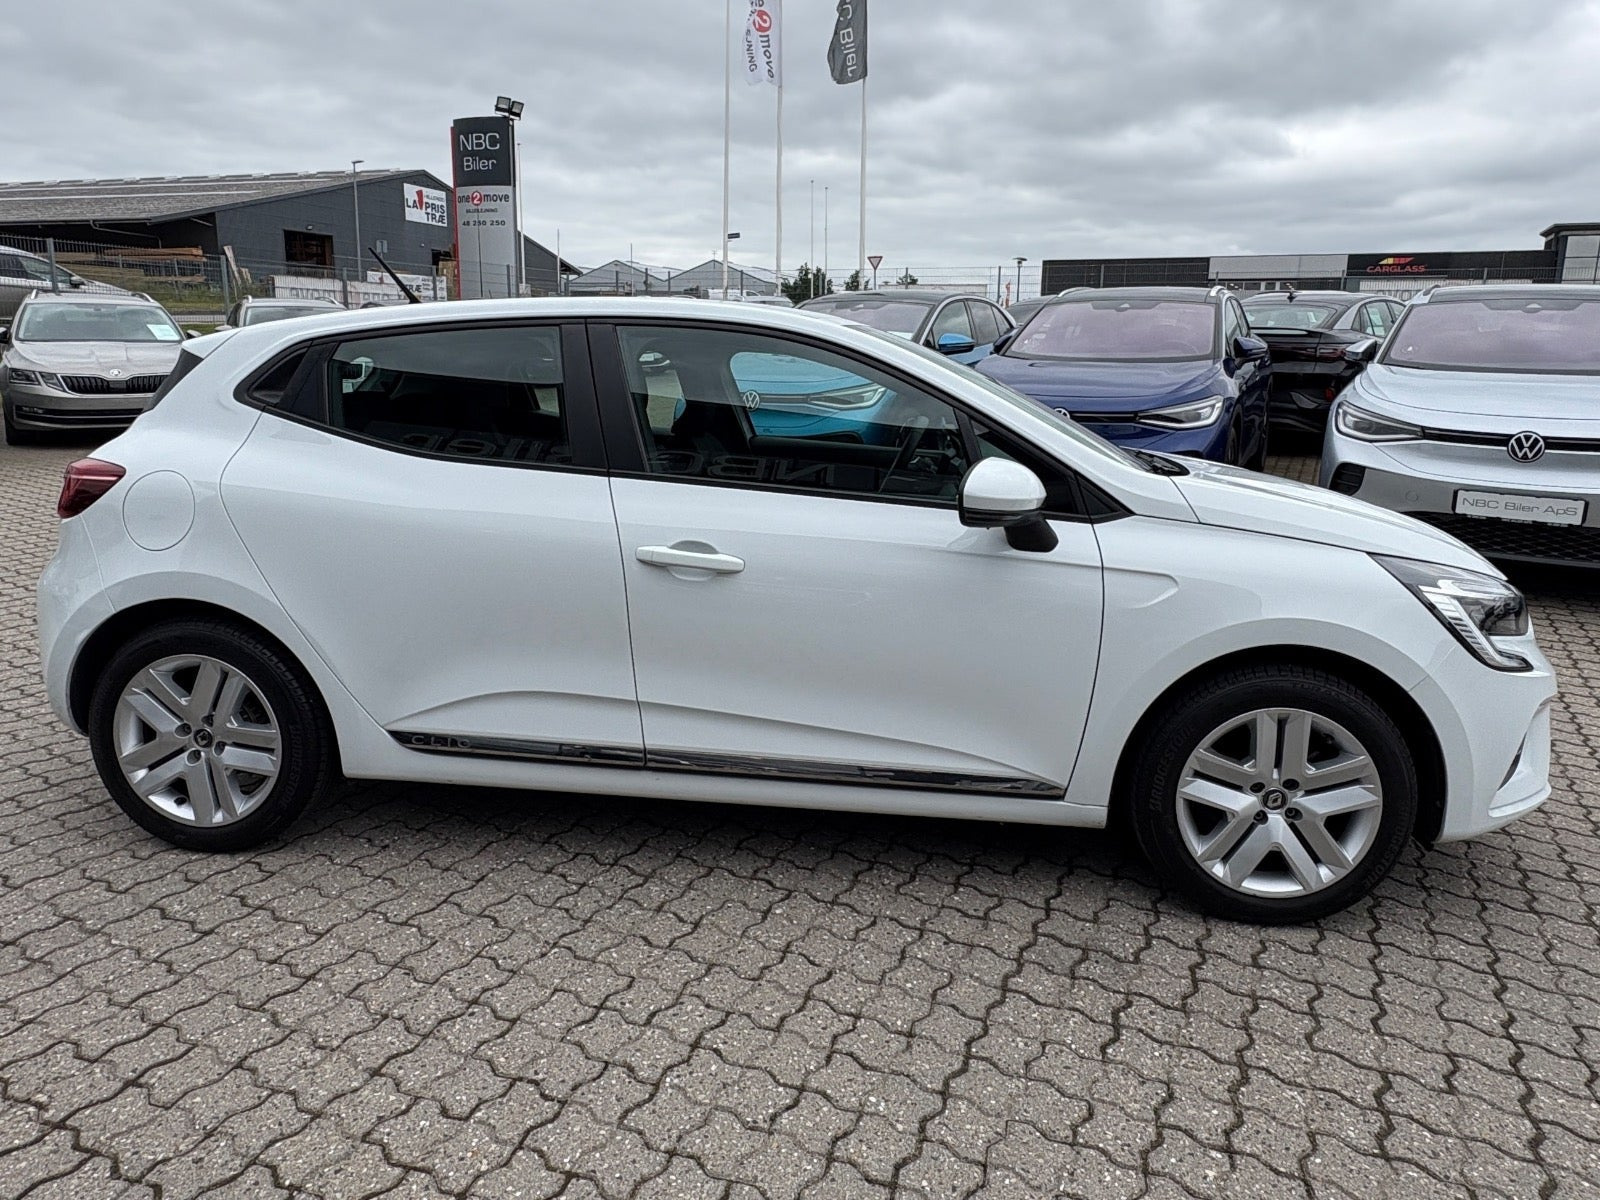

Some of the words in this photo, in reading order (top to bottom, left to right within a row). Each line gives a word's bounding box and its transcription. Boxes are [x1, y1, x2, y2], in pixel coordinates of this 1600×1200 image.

[460, 133, 500, 151] NBC
[463, 156, 497, 171] Biler
[458, 191, 510, 206] one2move
[425, 212, 446, 225] TRÆ
[490, 219, 506, 227] 250
[1366, 264, 1426, 273] CARGLASS
[1462, 497, 1499, 509] NBC
[1504, 502, 1540, 512] Biler
[1543, 505, 1578, 516] ApS
